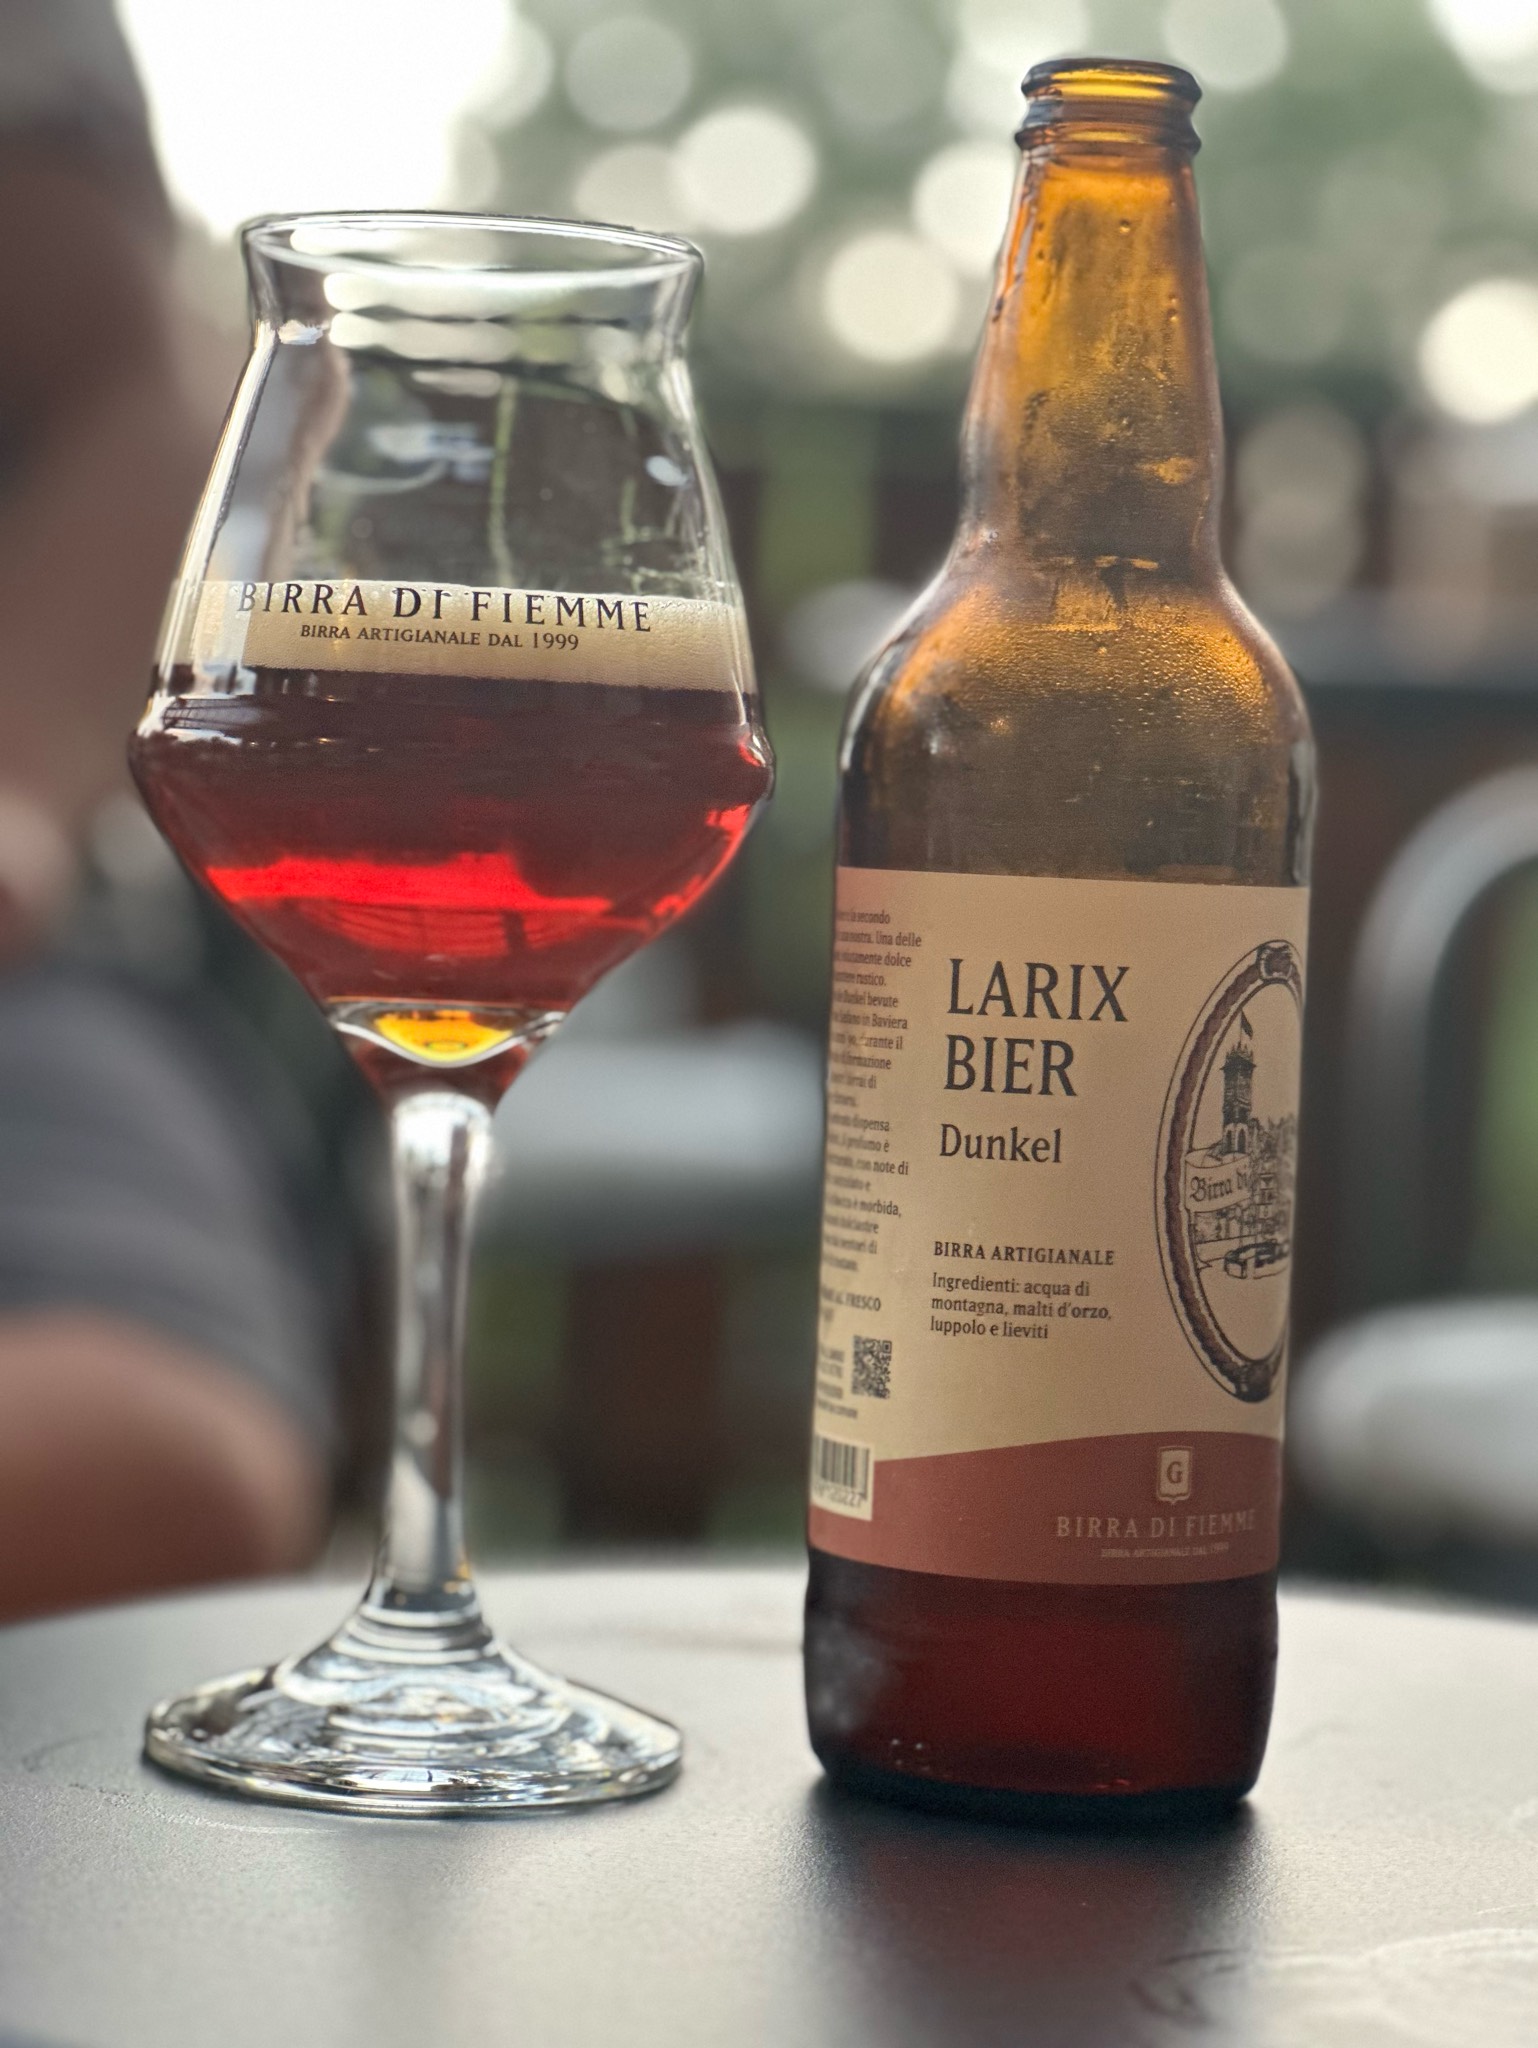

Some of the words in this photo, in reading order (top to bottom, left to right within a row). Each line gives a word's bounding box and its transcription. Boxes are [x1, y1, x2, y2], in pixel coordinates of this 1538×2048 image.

[237, 582, 368, 616] BIRRA
[393, 587, 444, 619] DI
[471, 591, 651, 632] FIEMME
[300, 624, 351, 640] BIRRA
[356, 627, 480, 646] ARTIGIANALE
[488, 633, 523, 648] DAL
[533, 632, 579, 650] 1999
[895, 932, 922, 947] delle
[884, 952, 912, 967] dolce
[867, 991, 899, 1008] bevute
[946, 958, 1131, 1022] LARIX
[872, 1013, 908, 1029] Baviera
[943, 1034, 1078, 1097] BIER
[939, 1123, 1062, 1164] Dunkel
[873, 1161, 896, 1174] note
[897, 1161, 909, 1175] di
[1190, 1175, 1233, 1202] Birra
[860, 1199, 901, 1218] morbida,
[934, 1241, 986, 1260] BIRRA
[990, 1245, 1115, 1266] ARTIGIANALE
[932, 1272, 1020, 1294] Ingredienti:
[1023, 1281, 1071, 1298] acqua
[1074, 1281, 1090, 1297] di
[846, 1292, 882, 1311] FRESCO
[931, 1298, 1009, 1317] montagna,
[1013, 1301, 1053, 1318] malti
[930, 1316, 986, 1337] luppolo
[989, 1324, 999, 1336] e
[1002, 1321, 1049, 1339] lieviti
[1166, 1461, 1183, 1484] G
[1057, 1515, 1138, 1538] BIRRA
[1151, 1516, 1176, 1537] DI
[1185, 1509, 1255, 1538] FIEMME
